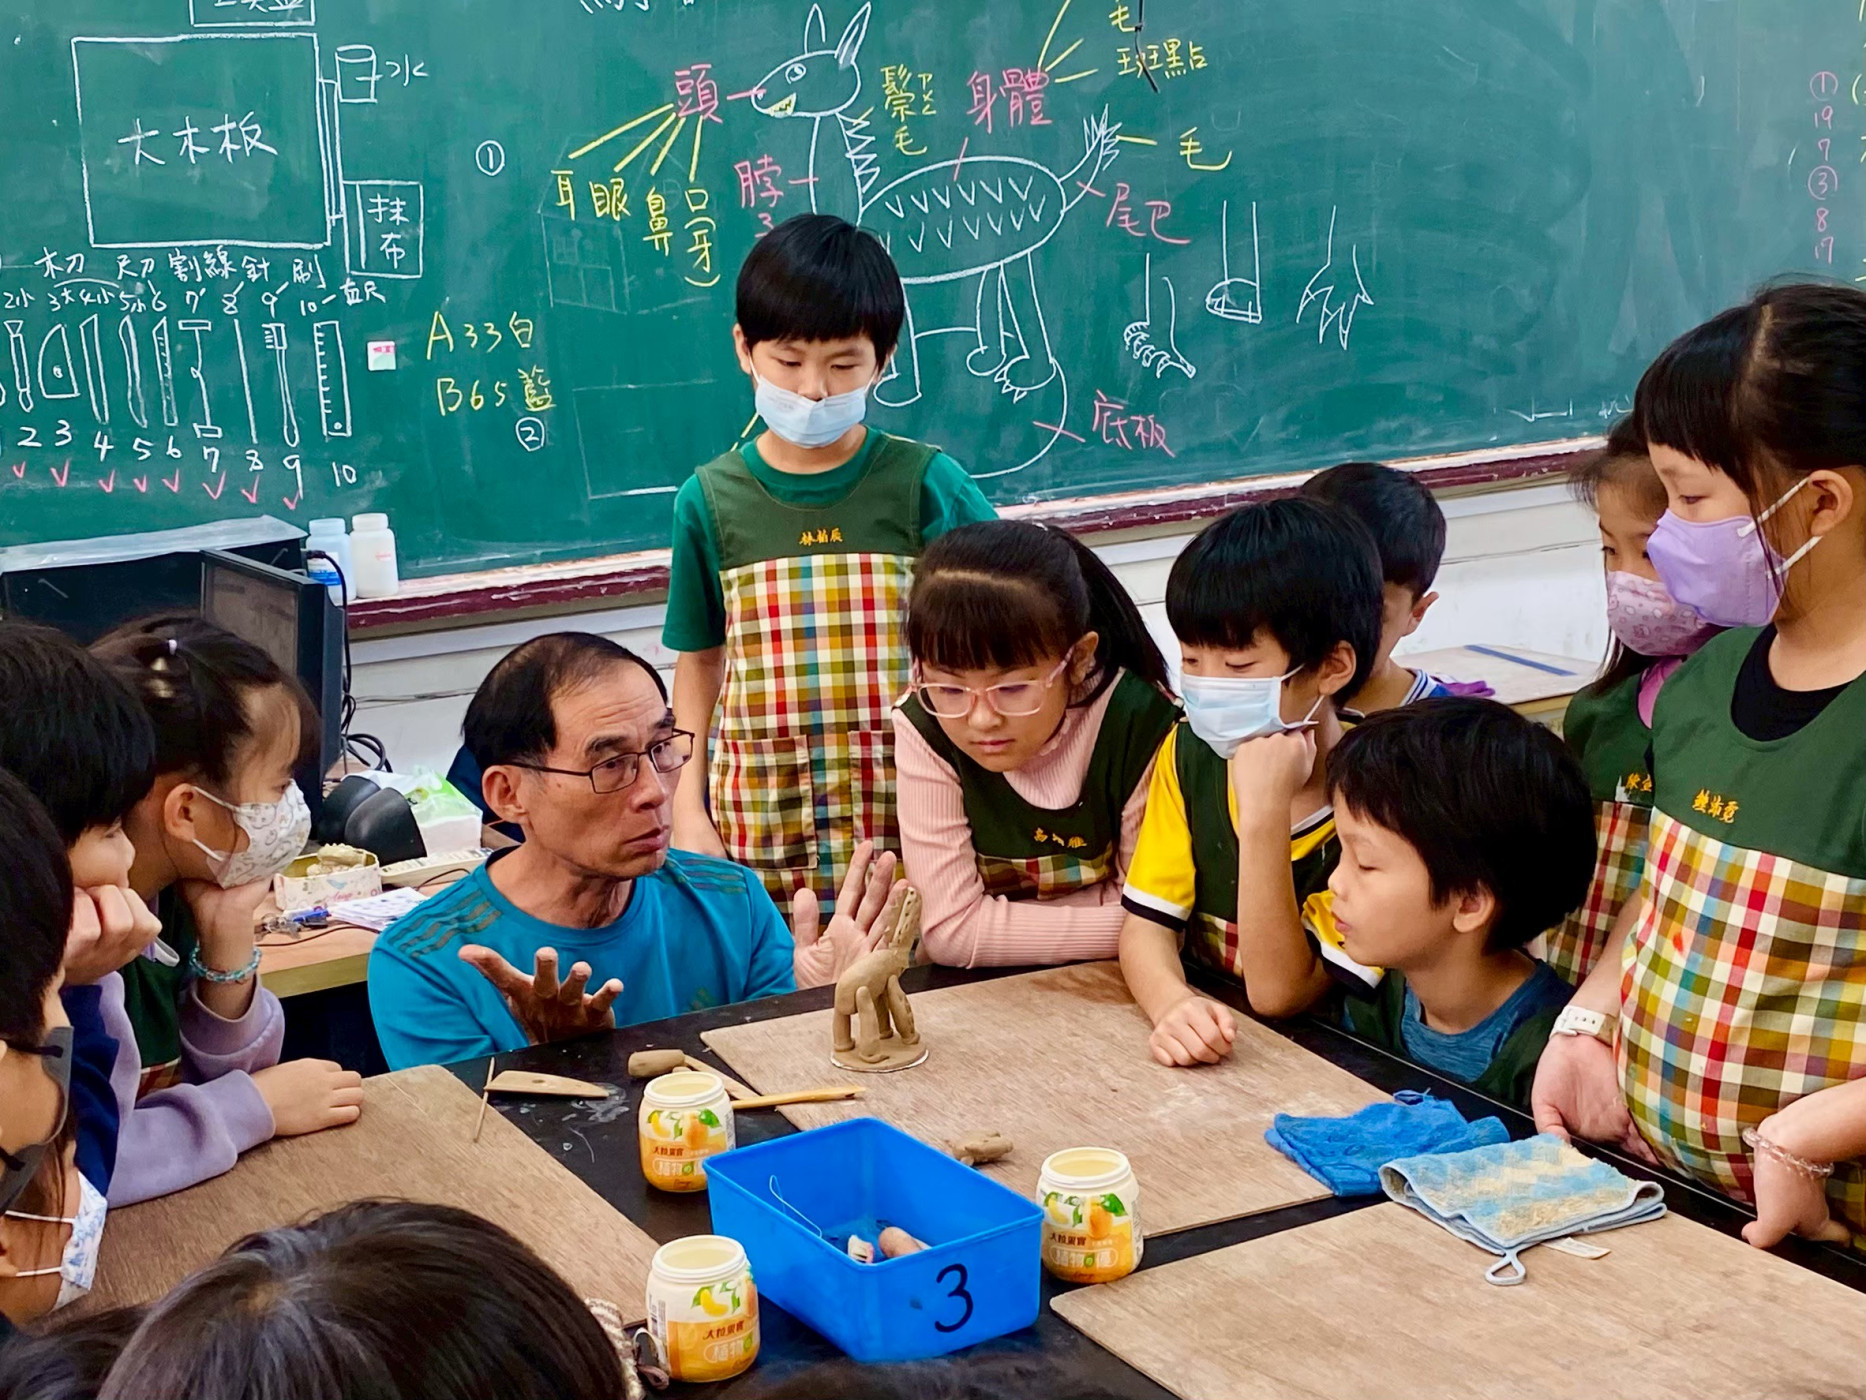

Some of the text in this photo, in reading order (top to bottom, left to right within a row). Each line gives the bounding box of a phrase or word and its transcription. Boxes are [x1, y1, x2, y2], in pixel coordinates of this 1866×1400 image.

[385, 53, 429, 87] 水
[674, 63, 723, 124] 頭
[966, 68, 1053, 134] 身體
[118, 111, 278, 164] 大木板
[1179, 127, 1232, 171] 毛
[550, 169, 576, 221] 耳
[589, 178, 631, 222] 眼
[1106, 182, 1191, 244] 尾巴
[366, 193, 410, 270] 抹布
[34, 246, 85, 279] 木刀
[1092, 389, 1176, 458] 底板
[17, 419, 357, 499] 2 3 4 5 6 7 8 9 10
[934, 1263, 974, 1333] 3
